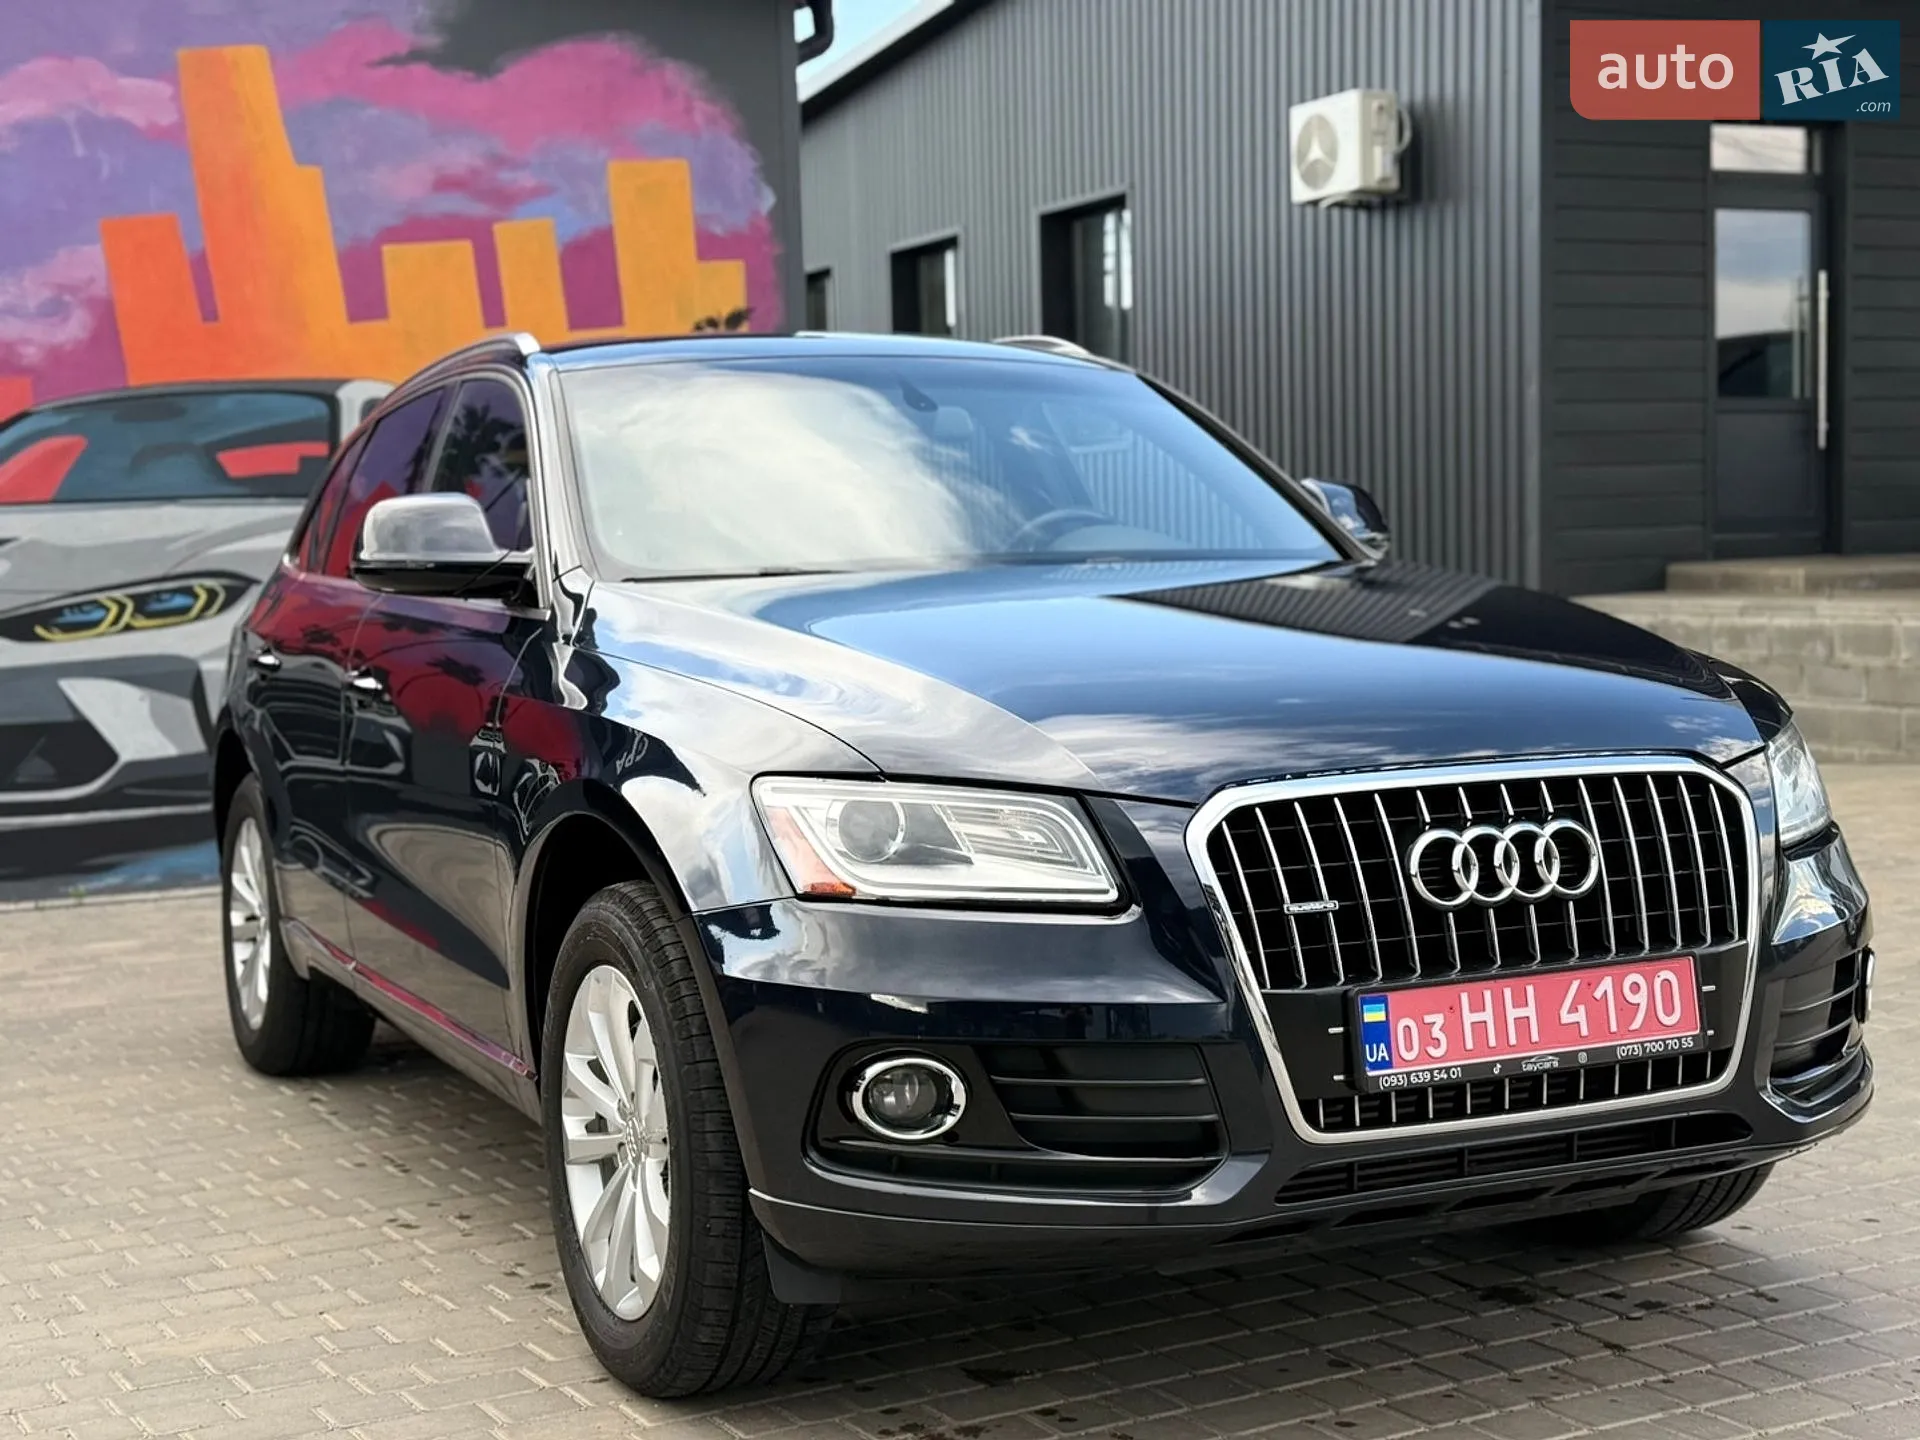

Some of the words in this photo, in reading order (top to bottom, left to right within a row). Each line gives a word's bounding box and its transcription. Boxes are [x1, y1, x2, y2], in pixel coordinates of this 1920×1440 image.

[1396, 1012, 1448, 1062] 03
[1459, 984, 1540, 1051] HH
[1558, 969, 1682, 1038] 4190
[1365, 1043, 1390, 1063] UA
[1616, 1043, 1643, 1060] (073)
[1644, 1041, 1664, 1053] 700
[1665, 1038, 1680, 1050] 70
[1681, 1037, 1694, 1048] 55
[1379, 1074, 1408, 1090] (093)
[1410, 1070, 1431, 1084] 639
[1433, 1068, 1448, 1080] 54
[1449, 1066, 1463, 1079] 01
